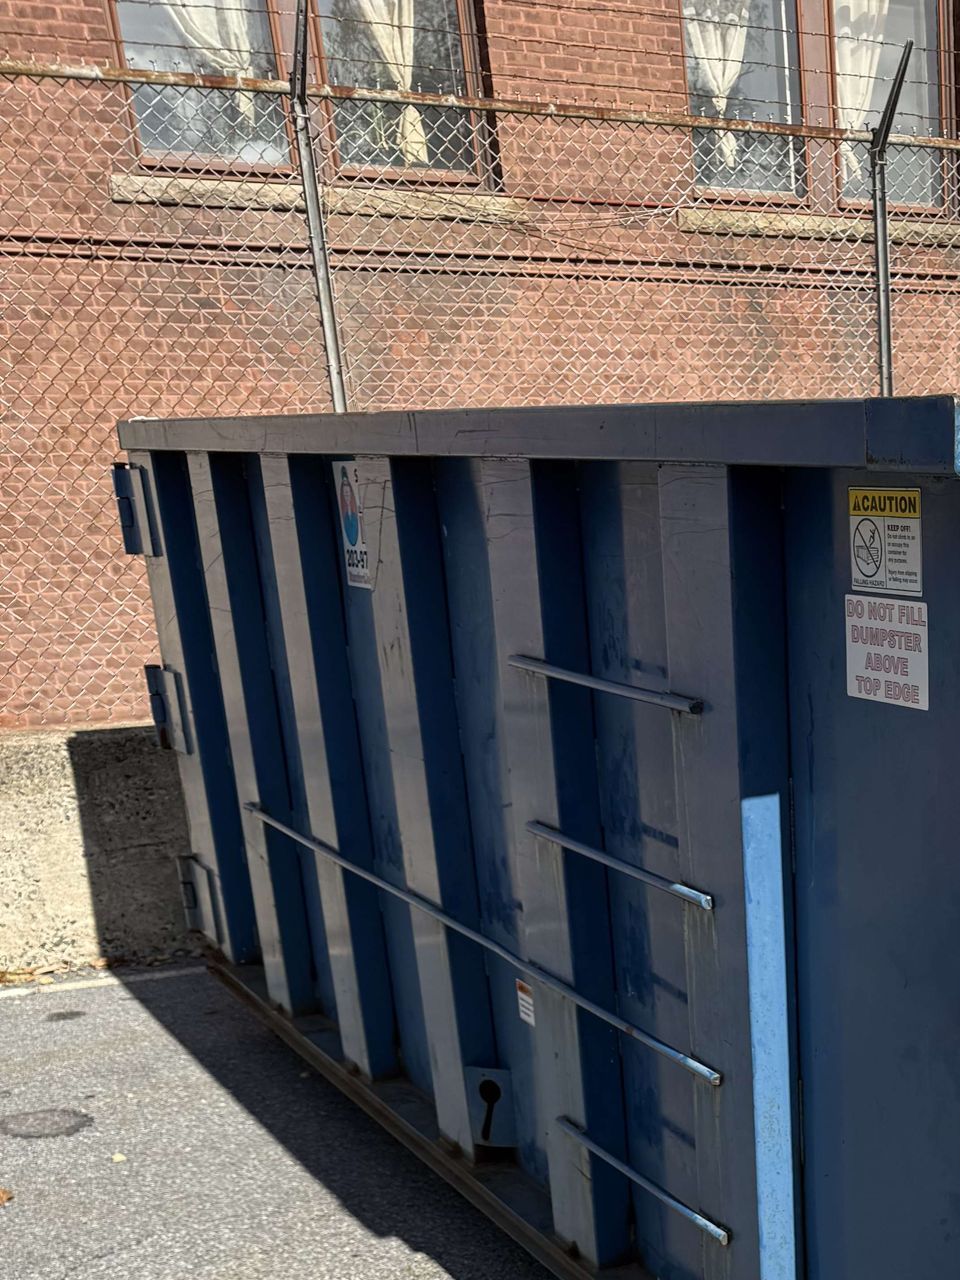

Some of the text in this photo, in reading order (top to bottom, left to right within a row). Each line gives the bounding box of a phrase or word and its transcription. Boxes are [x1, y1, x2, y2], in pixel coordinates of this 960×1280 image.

[862, 496, 917, 514] CAUTION
[887, 524, 899, 532] KEEP
[847, 598, 926, 627] DO NOT FILL
[851, 624, 922, 652] DUMPSTER
[864, 652, 909, 677] ABOVE
[856, 676, 920, 704] TOP EDGE
